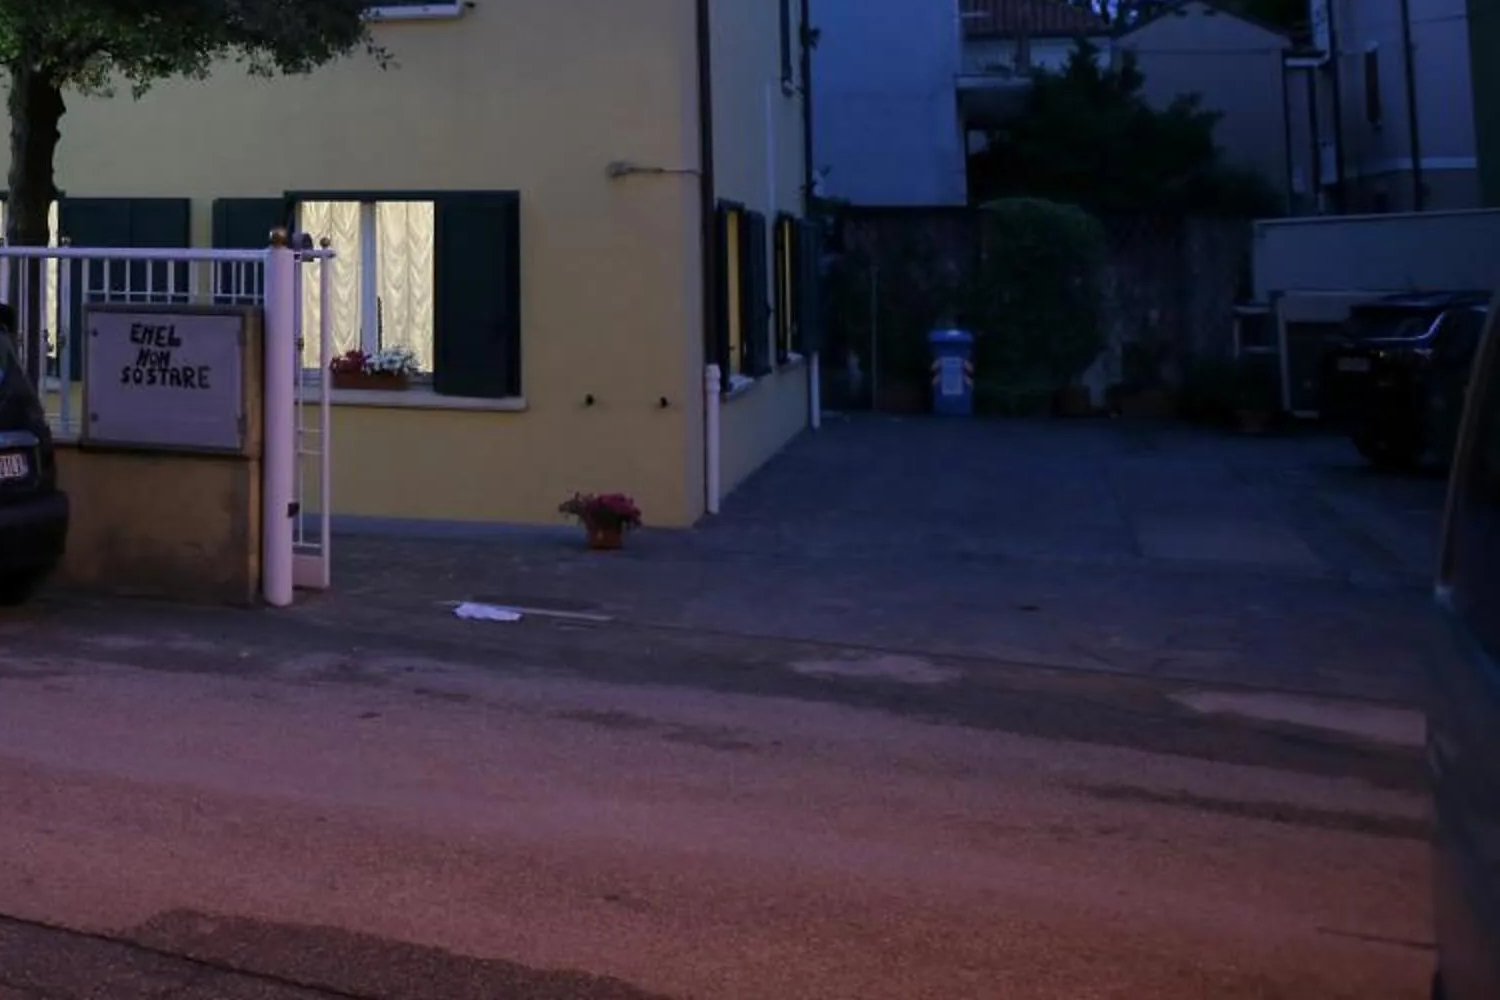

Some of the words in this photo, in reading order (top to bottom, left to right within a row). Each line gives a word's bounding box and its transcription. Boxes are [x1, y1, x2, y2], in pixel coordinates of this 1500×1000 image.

[130, 322, 182, 347] ENEL
[136, 348, 170, 368] NON
[120, 366, 211, 389] SOSTARE
